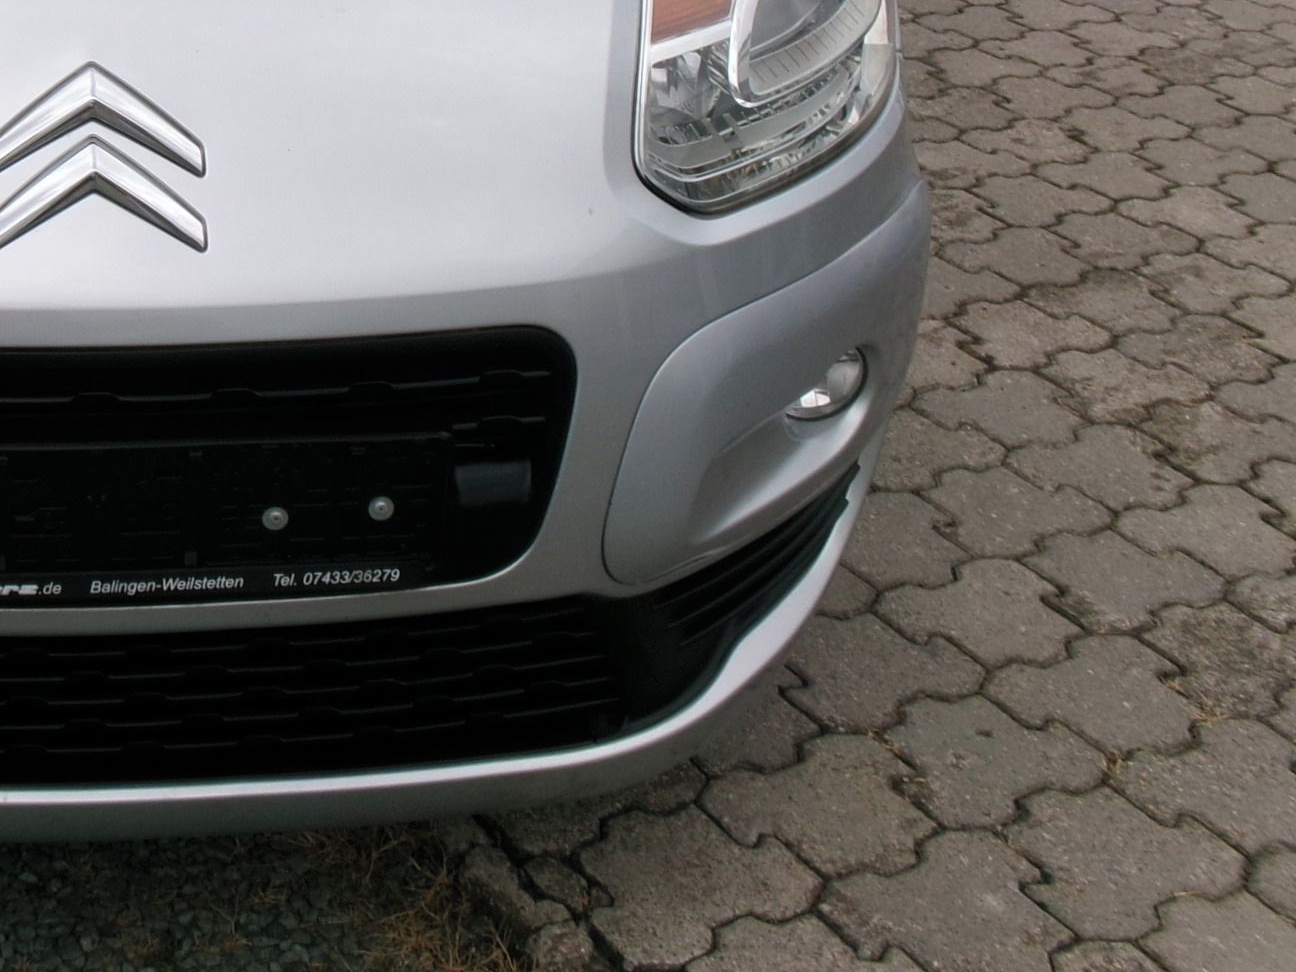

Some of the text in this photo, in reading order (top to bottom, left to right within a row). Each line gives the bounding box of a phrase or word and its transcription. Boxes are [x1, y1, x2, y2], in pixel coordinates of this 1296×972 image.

[90, 576, 244, 596] Balingen-Weilstetten
[273, 568, 401, 587] Tel. 07433/36279
